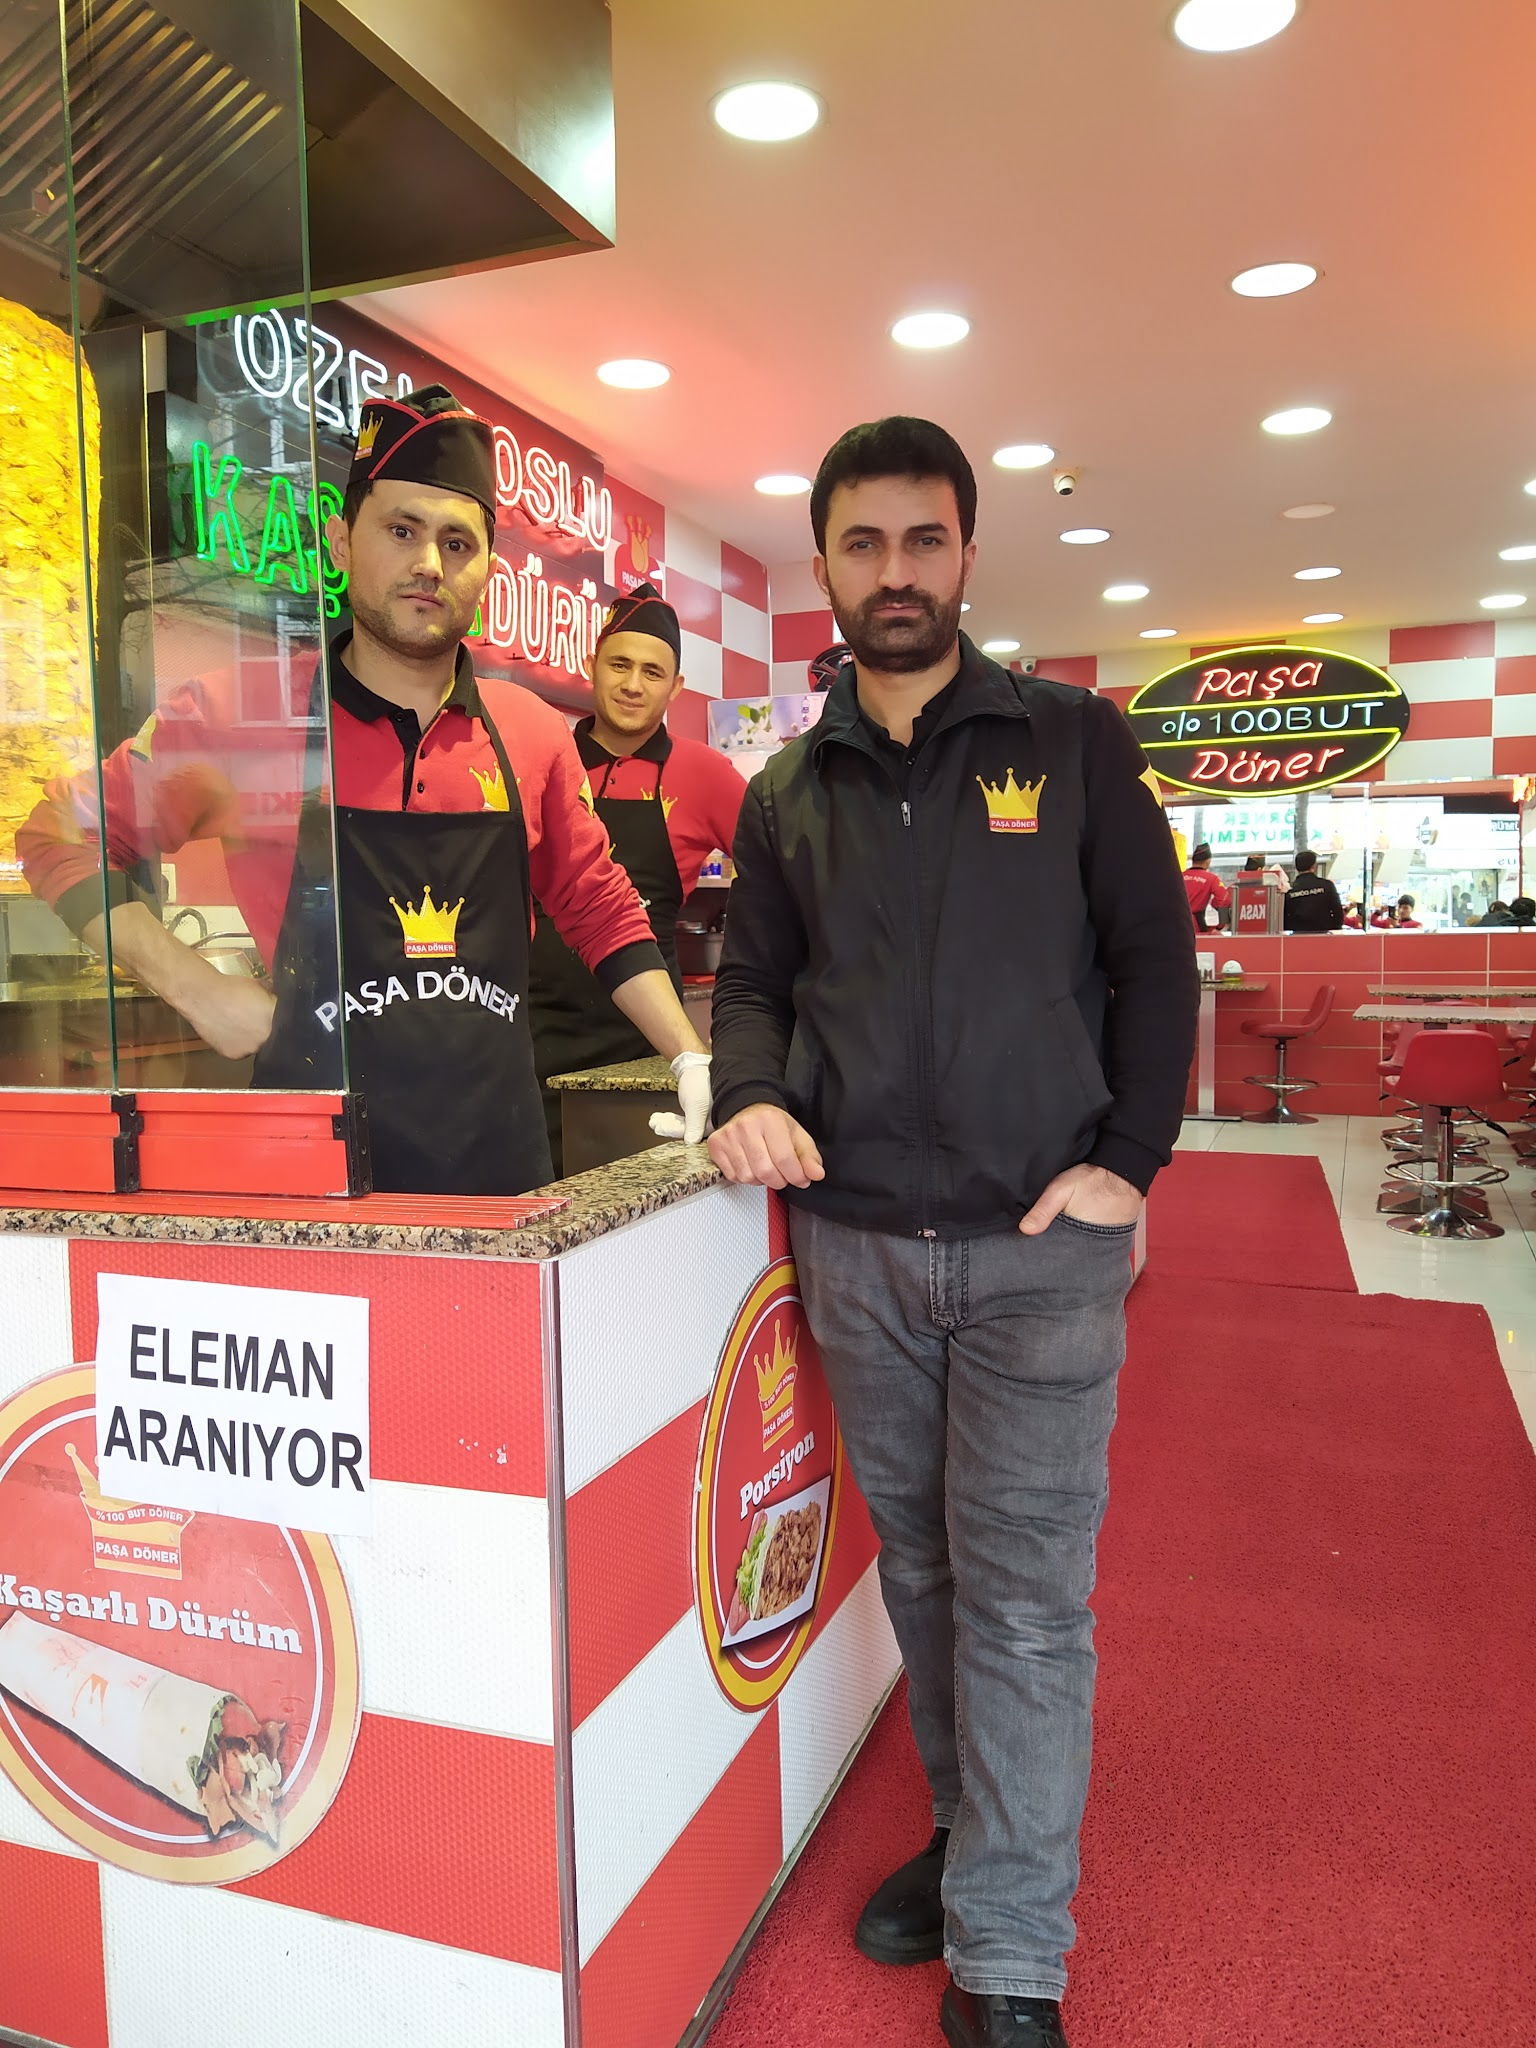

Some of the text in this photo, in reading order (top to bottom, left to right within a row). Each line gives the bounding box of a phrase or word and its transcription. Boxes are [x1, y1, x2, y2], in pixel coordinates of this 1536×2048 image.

[491, 426, 613, 551] OSLU
[1191, 748, 1345, 783] Döner
[991, 819, 1036, 828] PAŞA DÖNER
[406, 942, 454, 954] PAŞA DÖNER
[315, 975, 410, 1033] PAŞA
[130, 1323, 334, 1401] ELEMAN
[103, 1405, 366, 1493] ARANIYOR
[740, 1431, 815, 1521] Porsiyon
[96, 1507, 183, 1522] %100 BUT DÖNER
[95, 1541, 179, 1565] PAŞA DÖNER
[0, 1573, 303, 1654] Kaşarlı Dürüm
